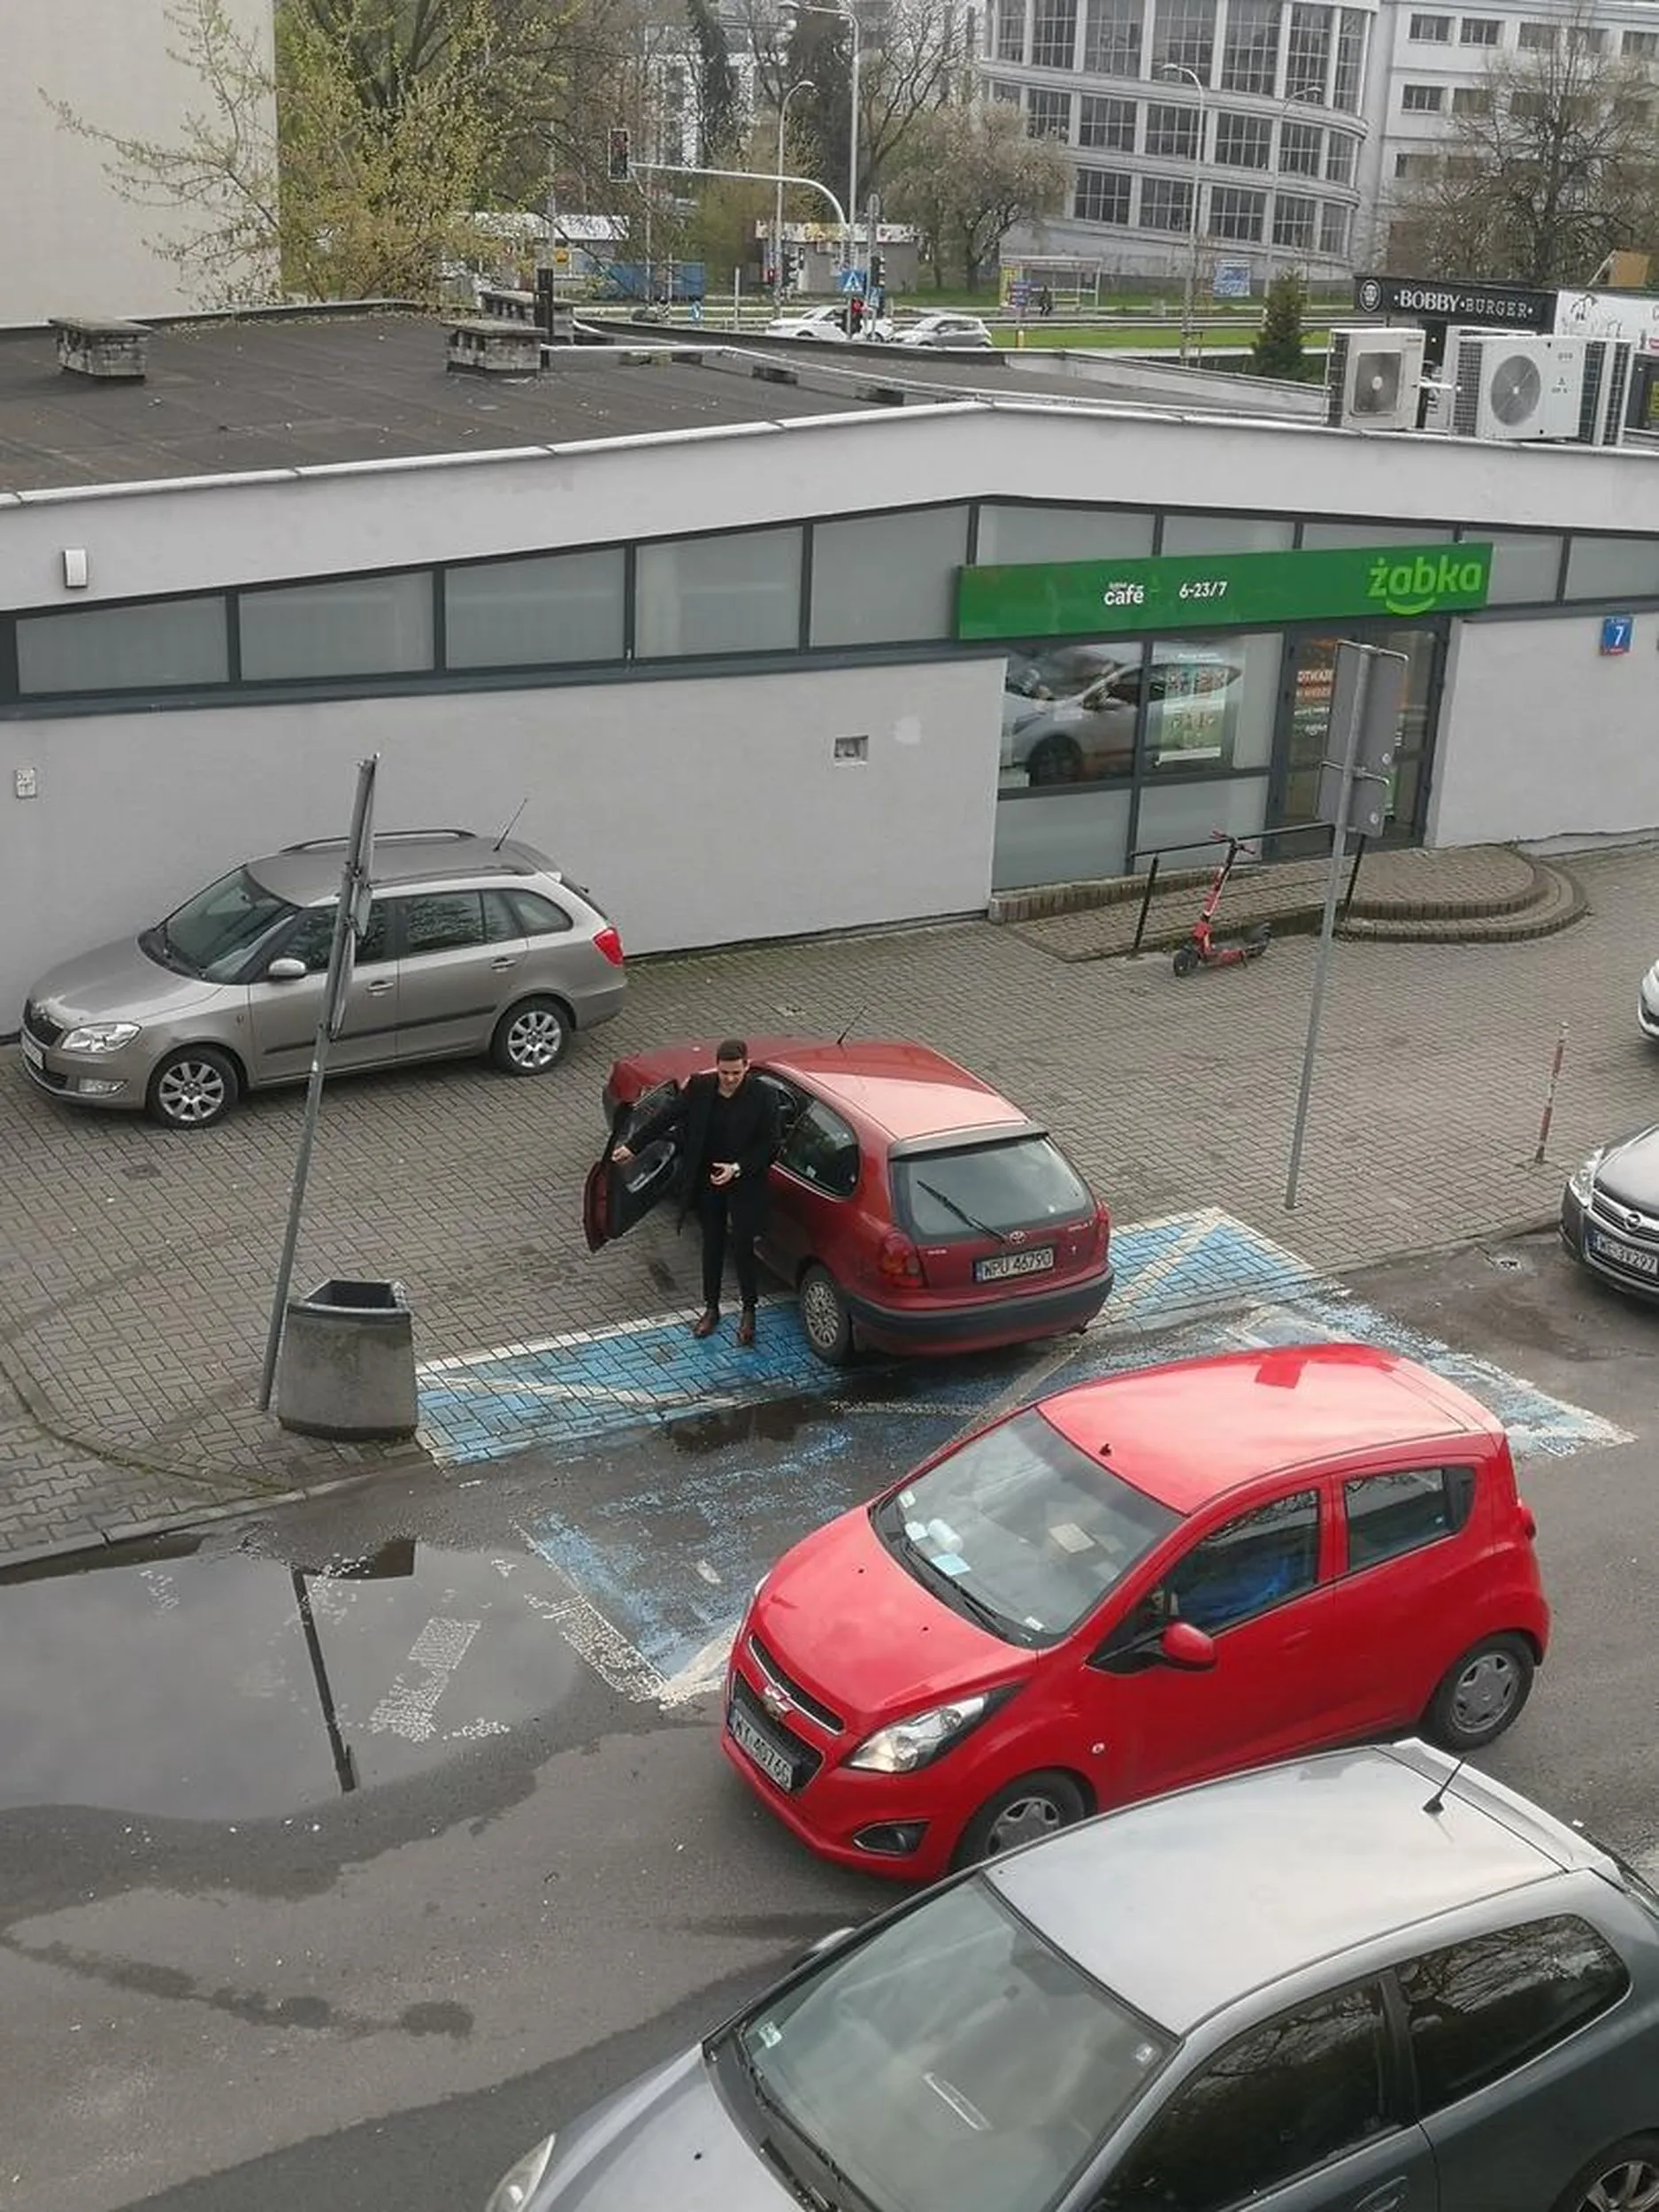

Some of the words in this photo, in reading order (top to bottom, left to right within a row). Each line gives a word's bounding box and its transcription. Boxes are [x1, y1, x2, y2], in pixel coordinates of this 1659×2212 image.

[1400, 289, 1460, 312] BOBBY
[1465, 297, 1528, 319] BURGER
[1368, 554, 1483, 598] żabka
[1103, 583, 1145, 605] café
[1179, 581, 1228, 599] 6-23/7
[1615, 626, 1624, 646] 7
